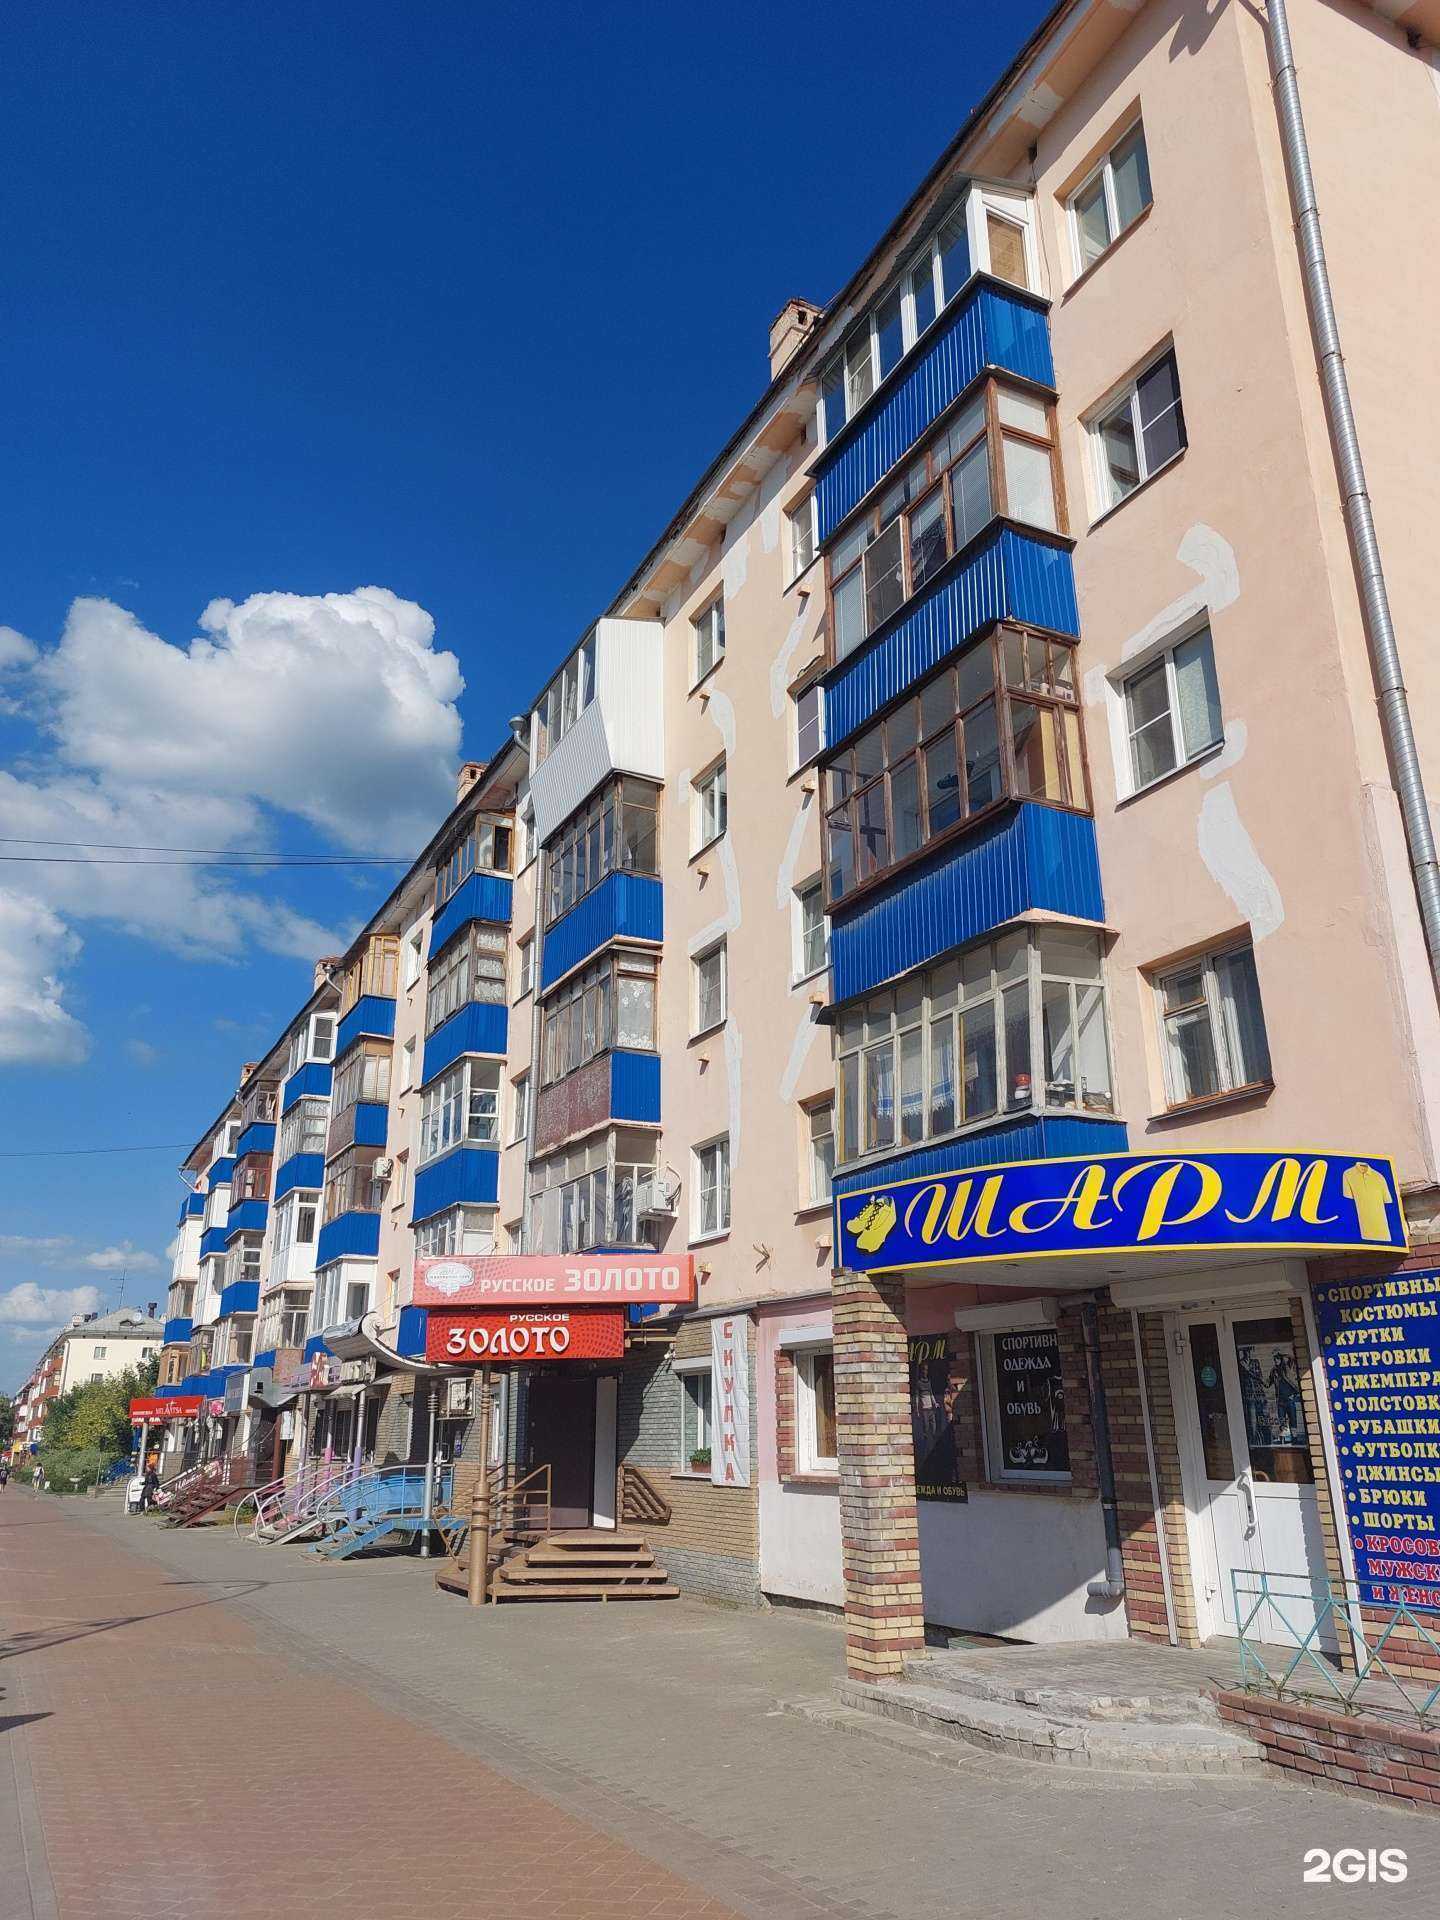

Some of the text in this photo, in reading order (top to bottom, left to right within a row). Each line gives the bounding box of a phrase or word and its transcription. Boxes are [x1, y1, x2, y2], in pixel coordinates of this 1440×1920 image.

[904, 1157, 1339, 1246] ШАРМ
[480, 1266, 681, 1294] РУССКОЕ ЗОЛОТО
[1327, 1276, 1440, 1303] СПОРТИВНЫ
[509, 1313, 570, 1323] РУССКОЕ
[1339, 1300, 1438, 1324] КОСТЮМЫ
[446, 1326, 571, 1356] ЗОЛОТО
[1001, 1333, 1058, 1351] СПОРТИВН
[1334, 1326, 1405, 1346] КУРТКИ
[1003, 1356, 1052, 1372] ОДЕЖДА
[1338, 1348, 1432, 1368] ВЕТРОВКИ
[1016, 1380, 1025, 1393] И
[723, 1321, 736, 1481] СКУПКА
[1006, 1401, 1042, 1417] ОБУВЬ
[1345, 1395, 1440, 1412] ТОЛСТОВК
[1348, 1419, 1440, 1435] РУБАШКИ
[1352, 1442, 1440, 1459] ФУТБОЛК
[1355, 1465, 1440, 1484] ДЖИНСЫ
[1360, 1488, 1428, 1507] БРЮКИ
[1362, 1511, 1436, 1532] ШОРТЫ
[1365, 1534, 1440, 1557] КРОСОВ
[1367, 1557, 1440, 1582] МУЖСК
[1388, 1584, 1440, 1607] ЖЕНС
